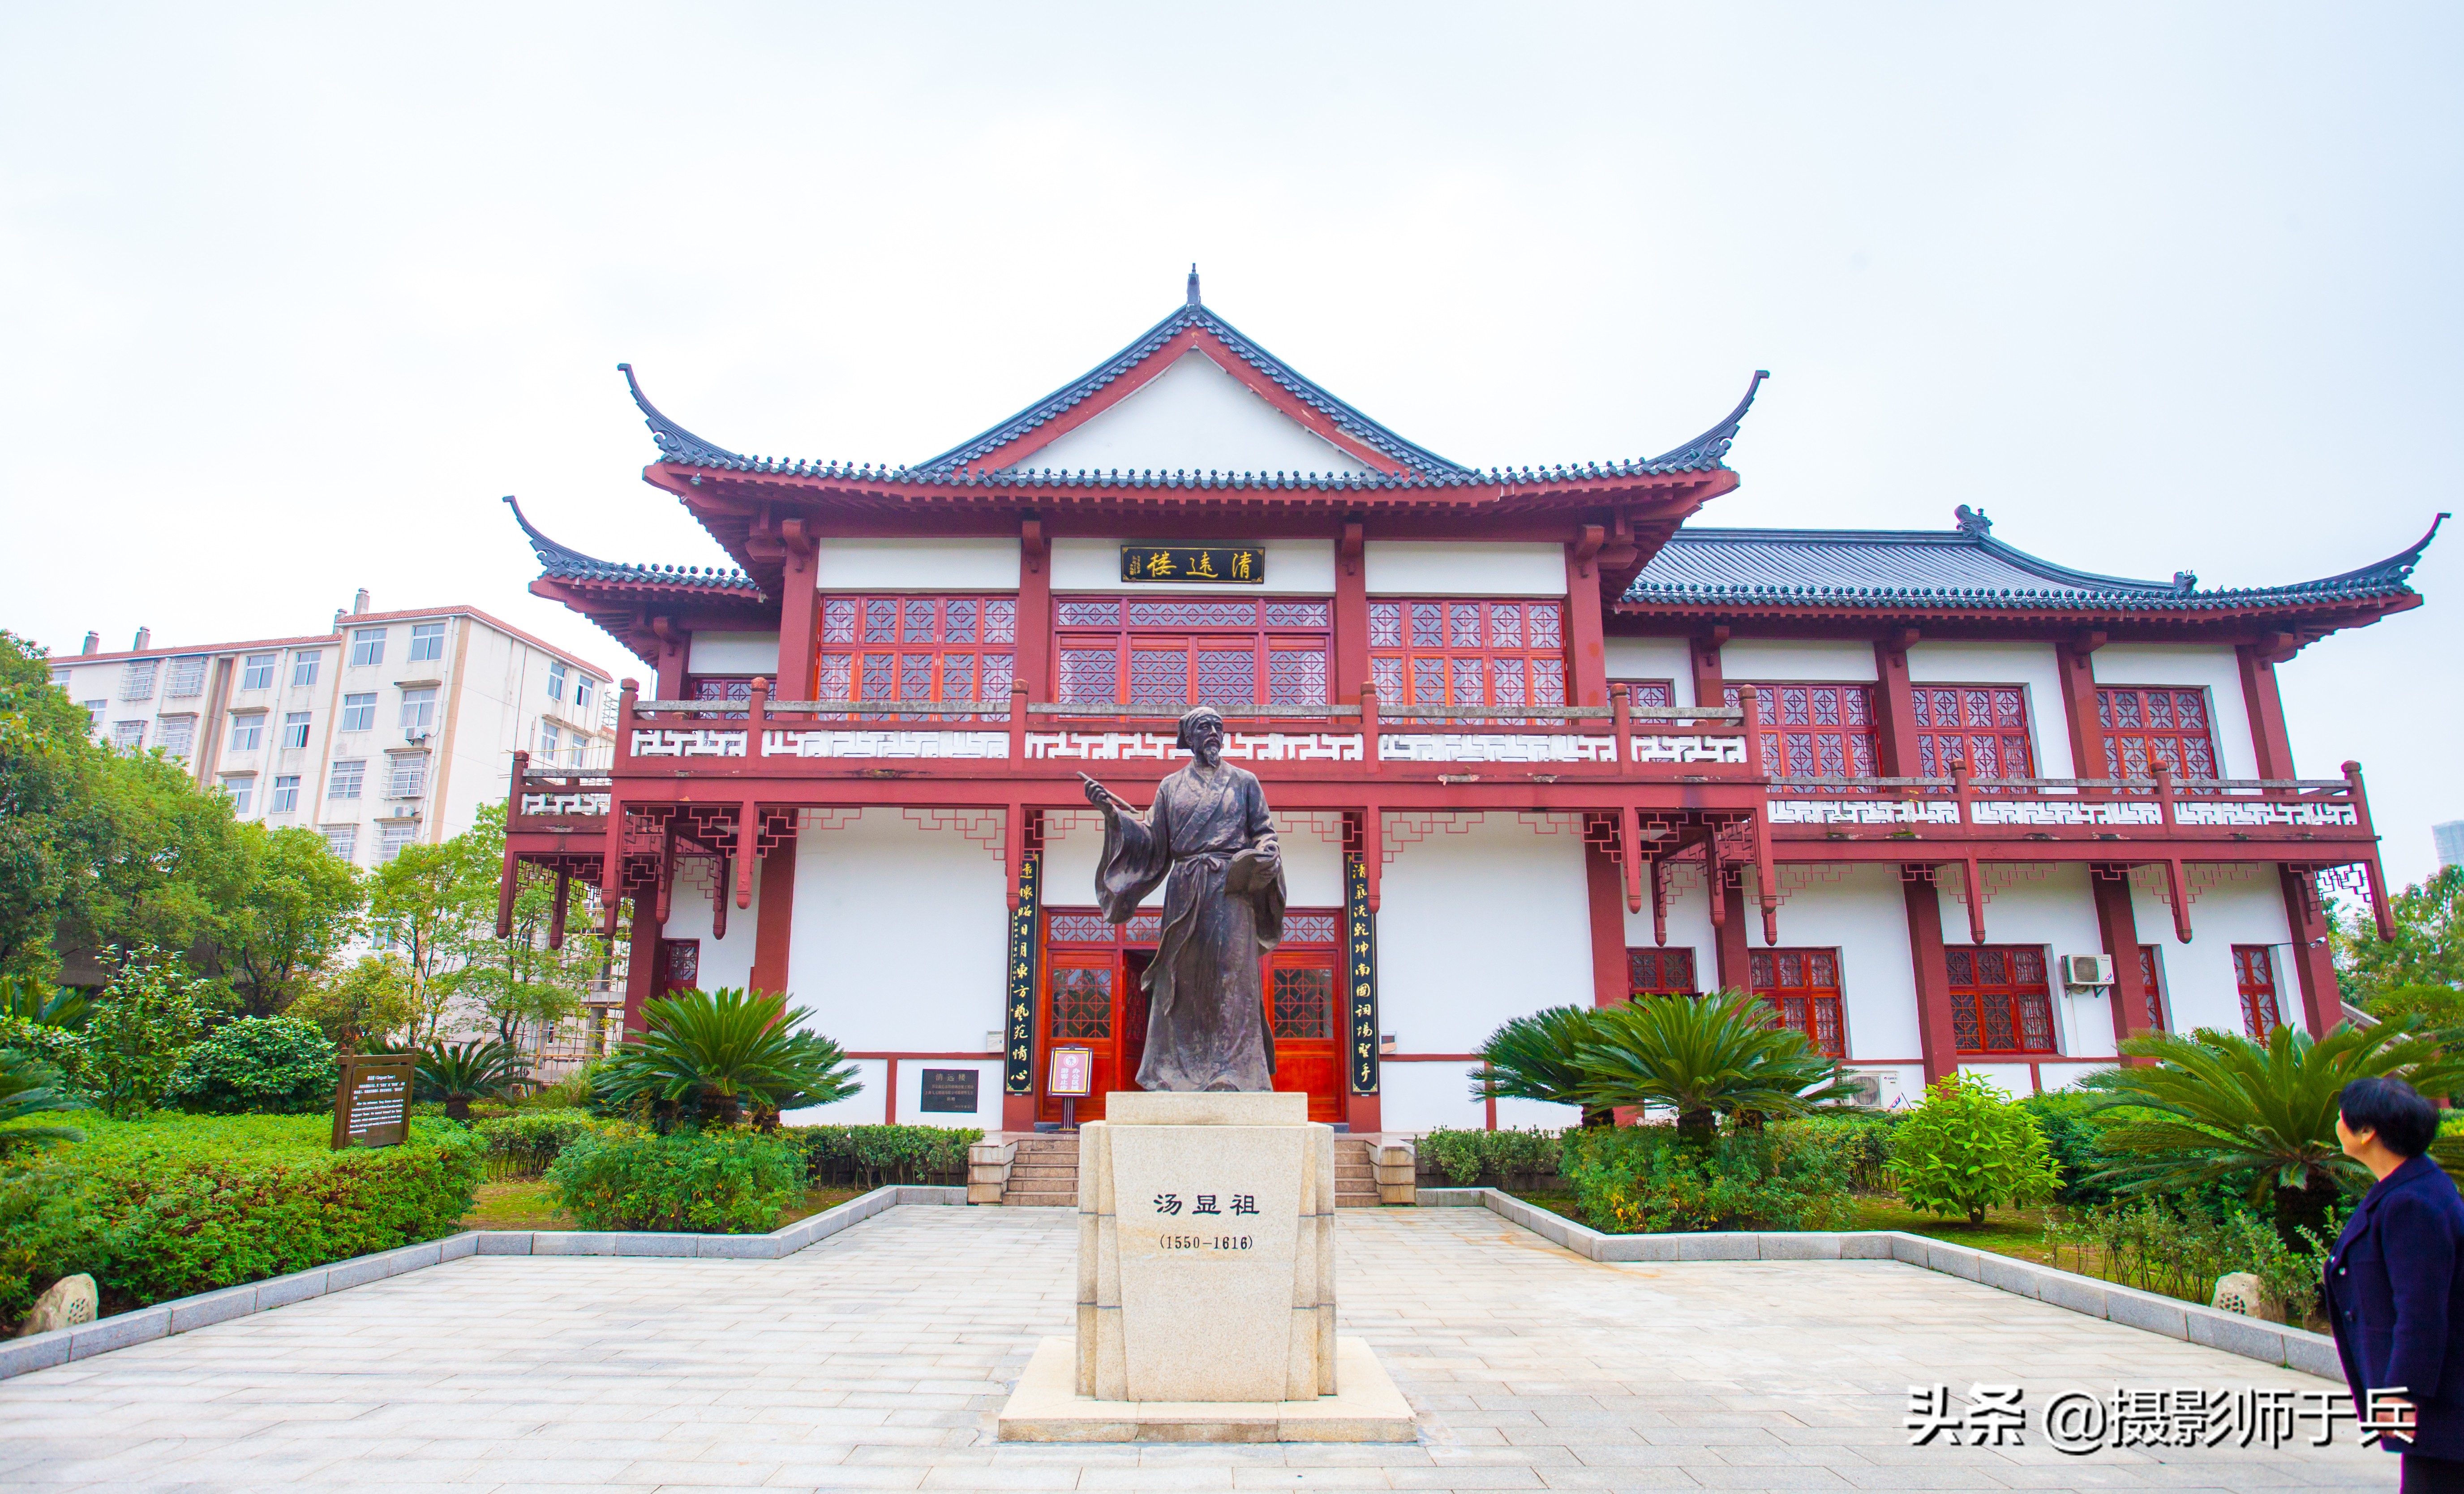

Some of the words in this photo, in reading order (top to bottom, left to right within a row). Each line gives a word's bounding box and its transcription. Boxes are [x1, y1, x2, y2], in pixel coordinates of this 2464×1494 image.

[1060, 1068, 1069, 1090] 游客止步
[1153, 1194, 1260, 1216] 汤显祖
